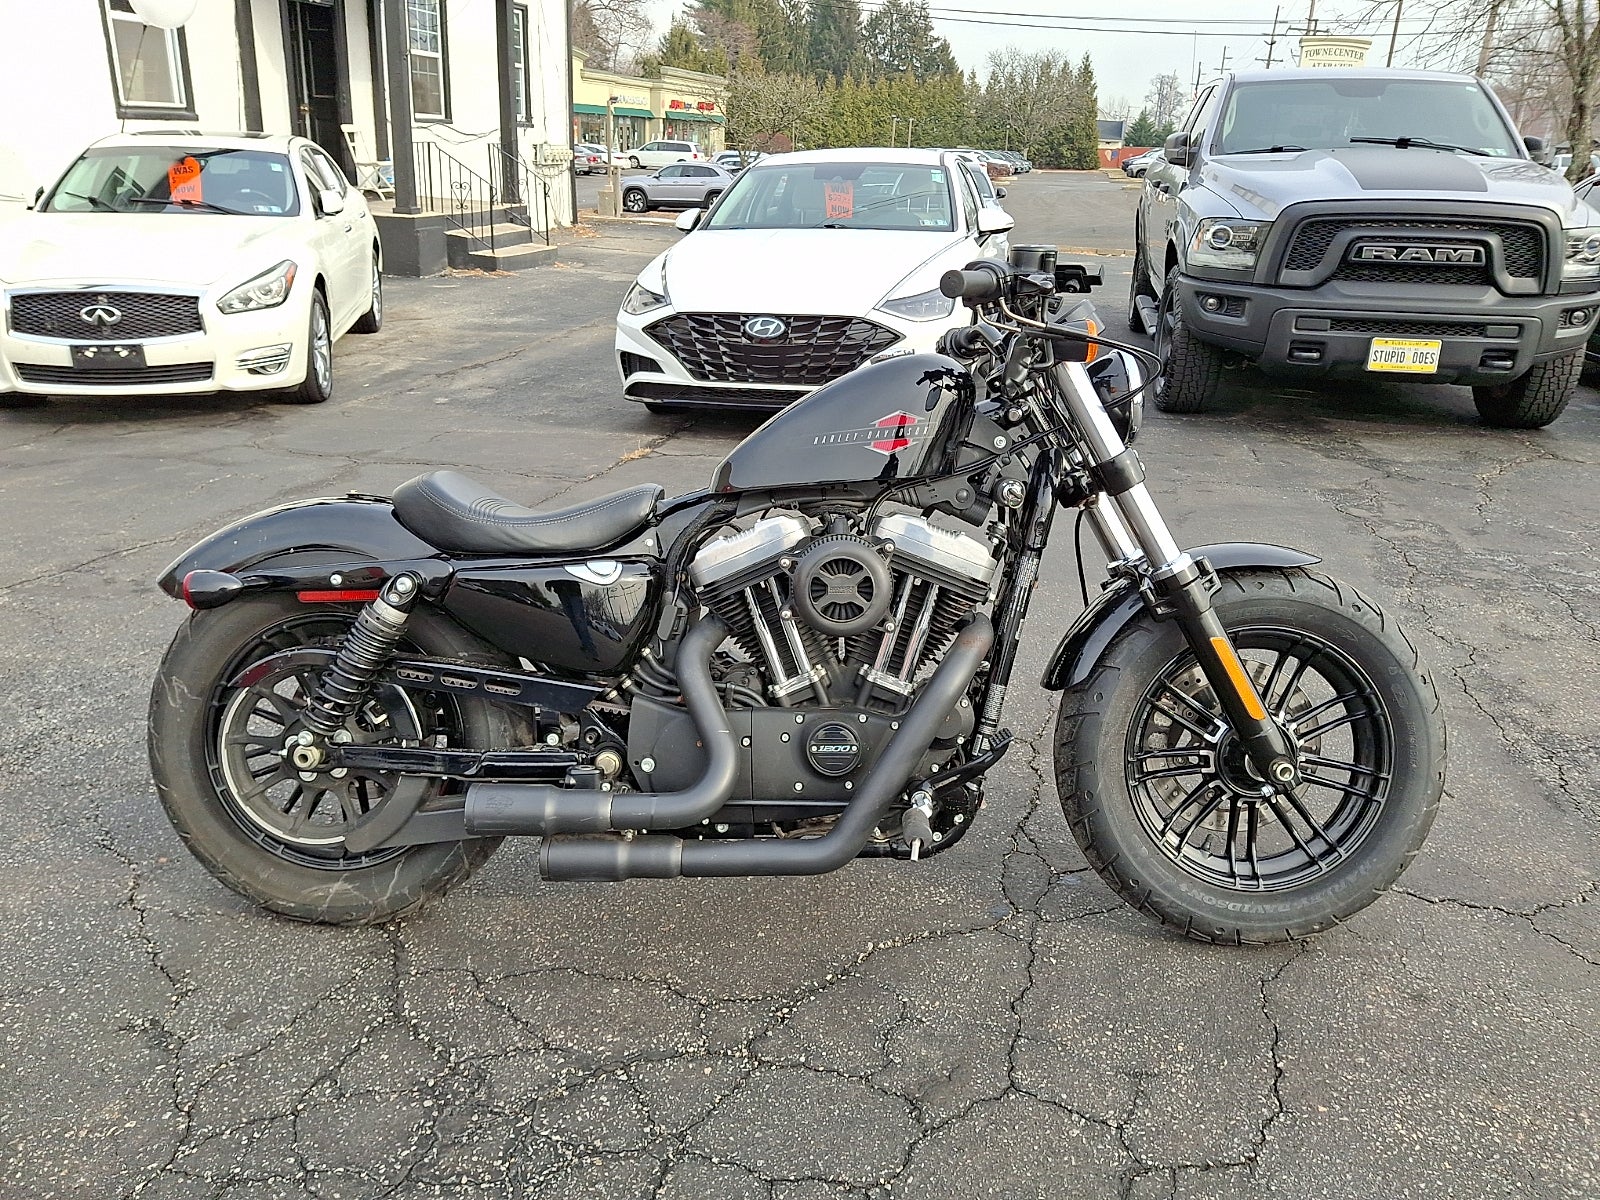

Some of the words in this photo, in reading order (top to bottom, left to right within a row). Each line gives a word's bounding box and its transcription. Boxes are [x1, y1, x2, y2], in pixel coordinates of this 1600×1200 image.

[173, 166, 194, 175] WAS
[1361, 246, 1476, 263] RAM
[1372, 349, 1406, 364] STUPID
[1412, 351, 1436, 365] DOES
[812, 426, 930, 446] HARLEY-DAVIDSON
